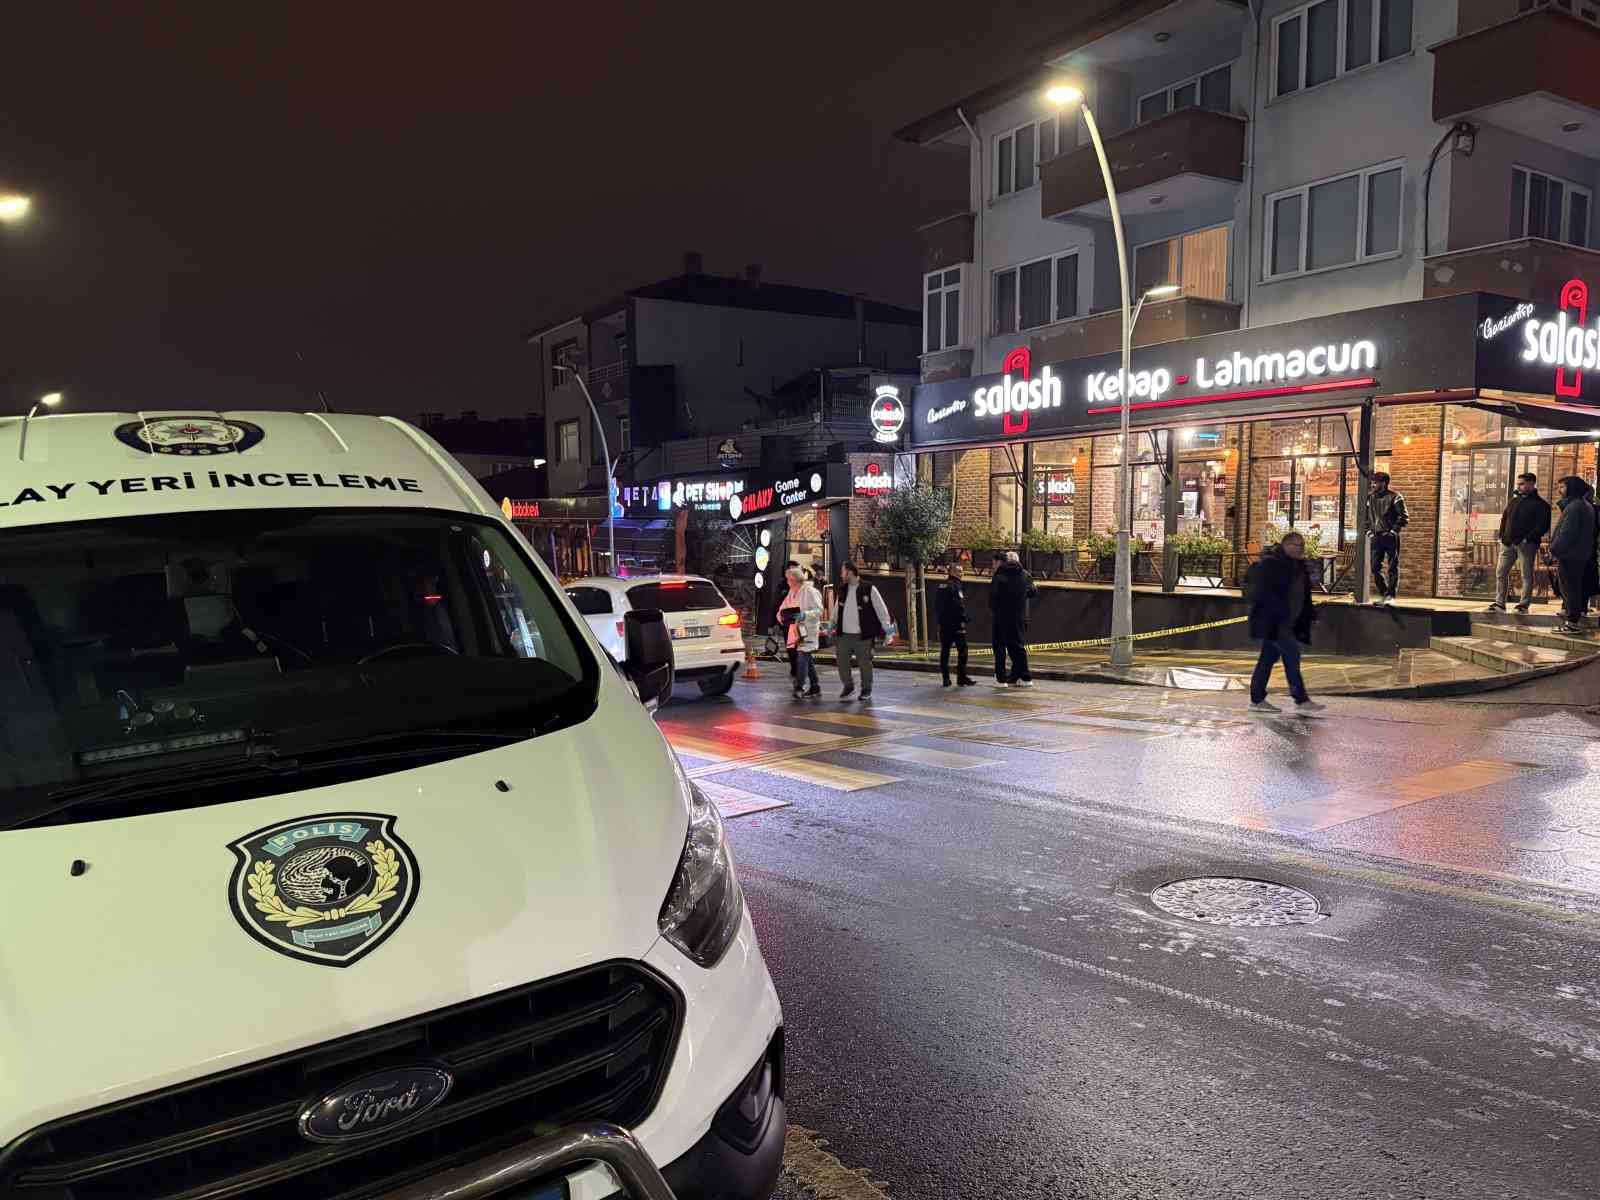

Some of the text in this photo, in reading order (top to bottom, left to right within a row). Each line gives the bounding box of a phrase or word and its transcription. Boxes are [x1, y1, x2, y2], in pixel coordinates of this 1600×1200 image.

[1522, 310, 1600, 371] salas
[1087, 367, 1170, 402] Kebap
[1196, 340, 1377, 389] Lahmacun
[974, 365, 1062, 417] salash
[88, 472, 196, 496] YERİ
[208, 471, 423, 493] İNCELEME
[685, 483, 705, 502] PET
[775, 478, 800, 494] Game
[742, 487, 773, 514] GALAXY
[781, 489, 807, 506] Center
[338, 1081, 420, 1130] Ford
